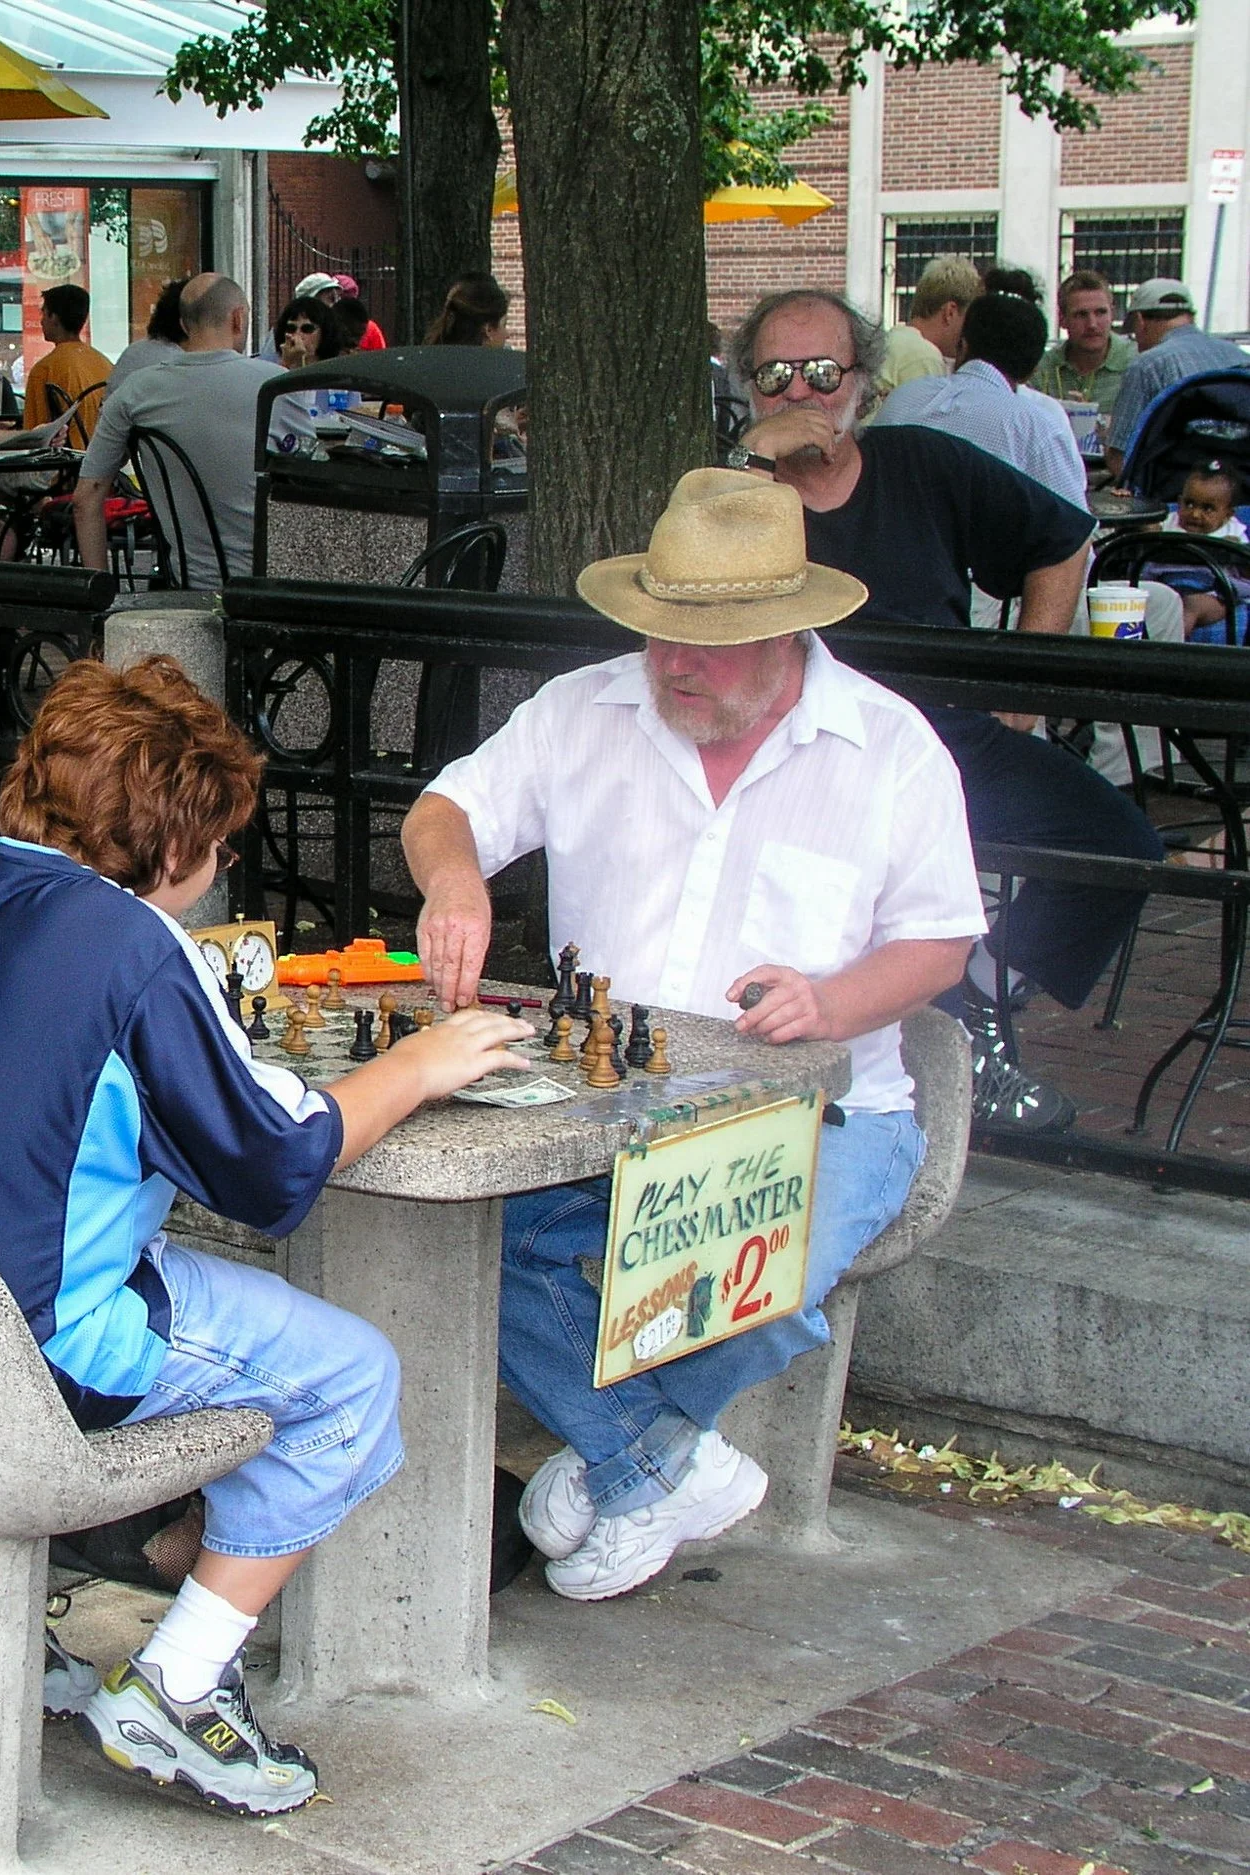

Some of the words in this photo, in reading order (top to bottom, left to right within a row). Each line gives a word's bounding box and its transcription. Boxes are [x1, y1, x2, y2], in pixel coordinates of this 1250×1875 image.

[35, 191, 75, 208] FRESH
[633, 1166, 711, 1225] PLAY
[724, 1144, 785, 1190] THE
[608, 1260, 698, 1351] LESSONS
